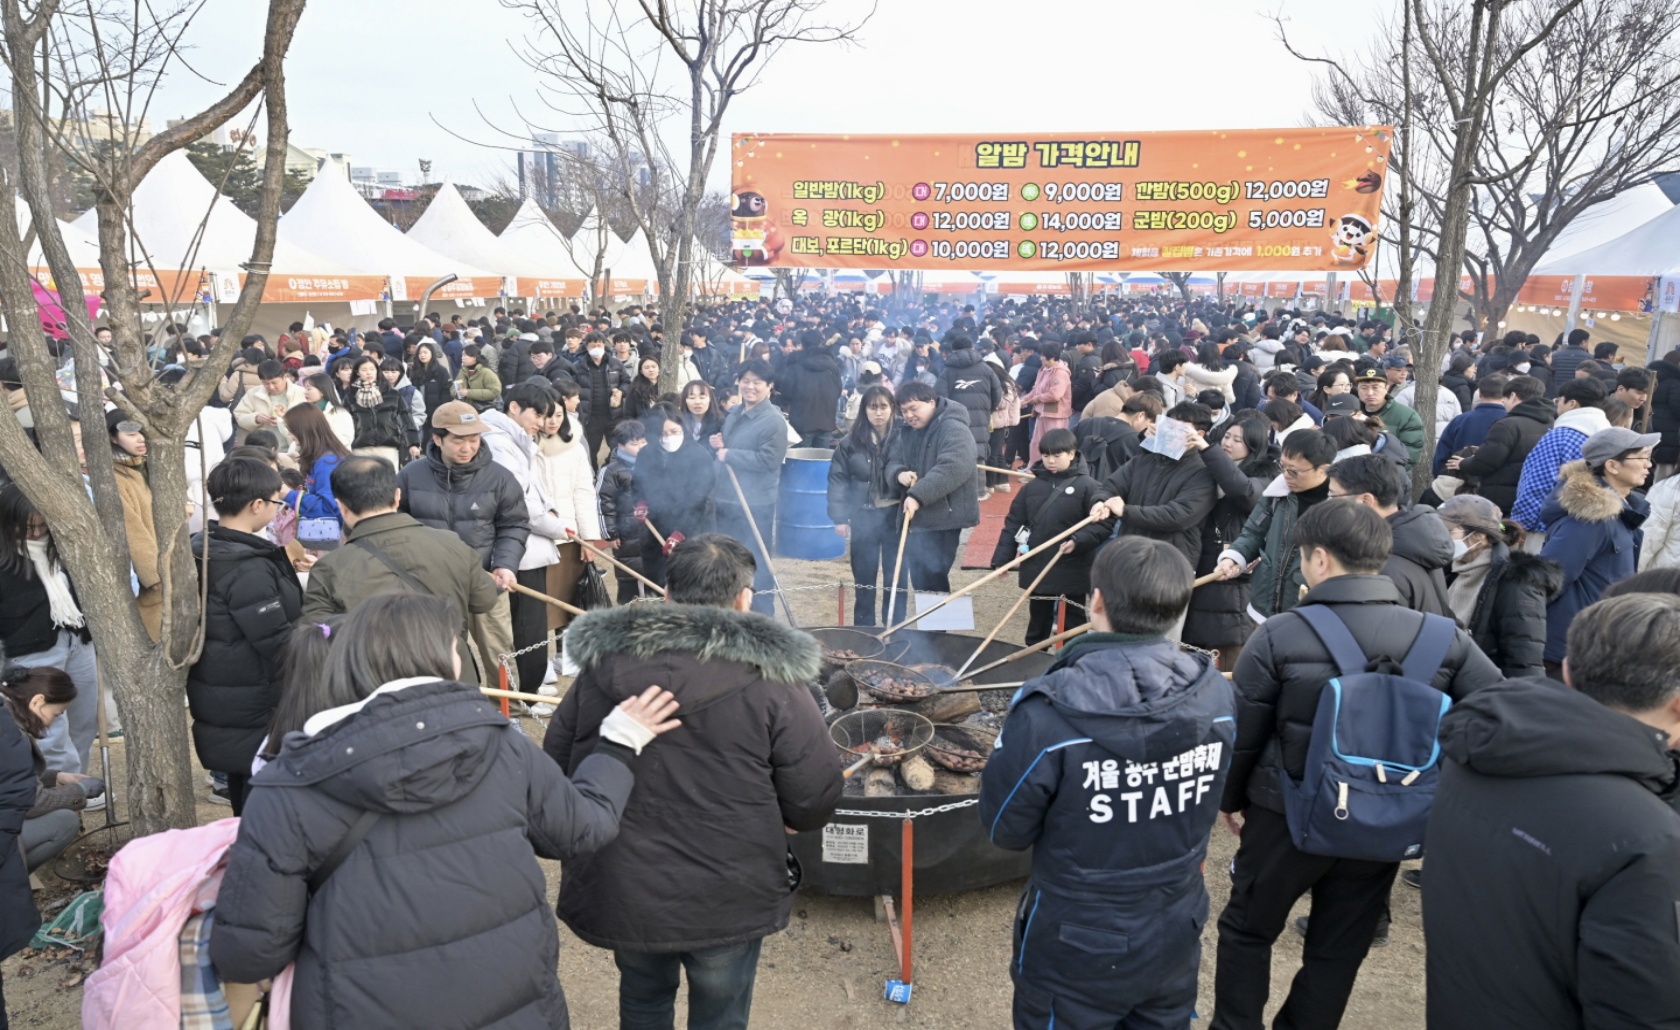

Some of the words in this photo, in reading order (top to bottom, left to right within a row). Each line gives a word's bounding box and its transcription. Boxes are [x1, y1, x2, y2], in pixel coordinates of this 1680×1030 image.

[976, 141, 1029, 168] 알밤
[1034, 140, 1141, 168] 가격안내
[793, 181, 885, 204] 일반밤(1kg)
[934, 182, 1009, 203] 7,000원
[1043, 182, 1122, 203] 9,000원
[1135, 180, 1240, 205] 깐밤(500g)
[1245, 178, 1330, 202] 12,000원
[791, 208, 808, 227] 옥
[932, 211, 1010, 232] 12,000원
[1041, 211, 1122, 232] 14,000원
[1133, 210, 1237, 234] 군밤(200g)
[1248, 208, 1325, 231] 5,000원
[826, 236, 908, 260] 포르단(1kg)
[931, 240, 1009, 261] 10,000원
[1039, 240, 1120, 261] 12,000원
[1256, 245, 1301, 258] 1,000원
[1082, 759, 1120, 791] 겨울
[1089, 774, 1215, 823] STAFF
